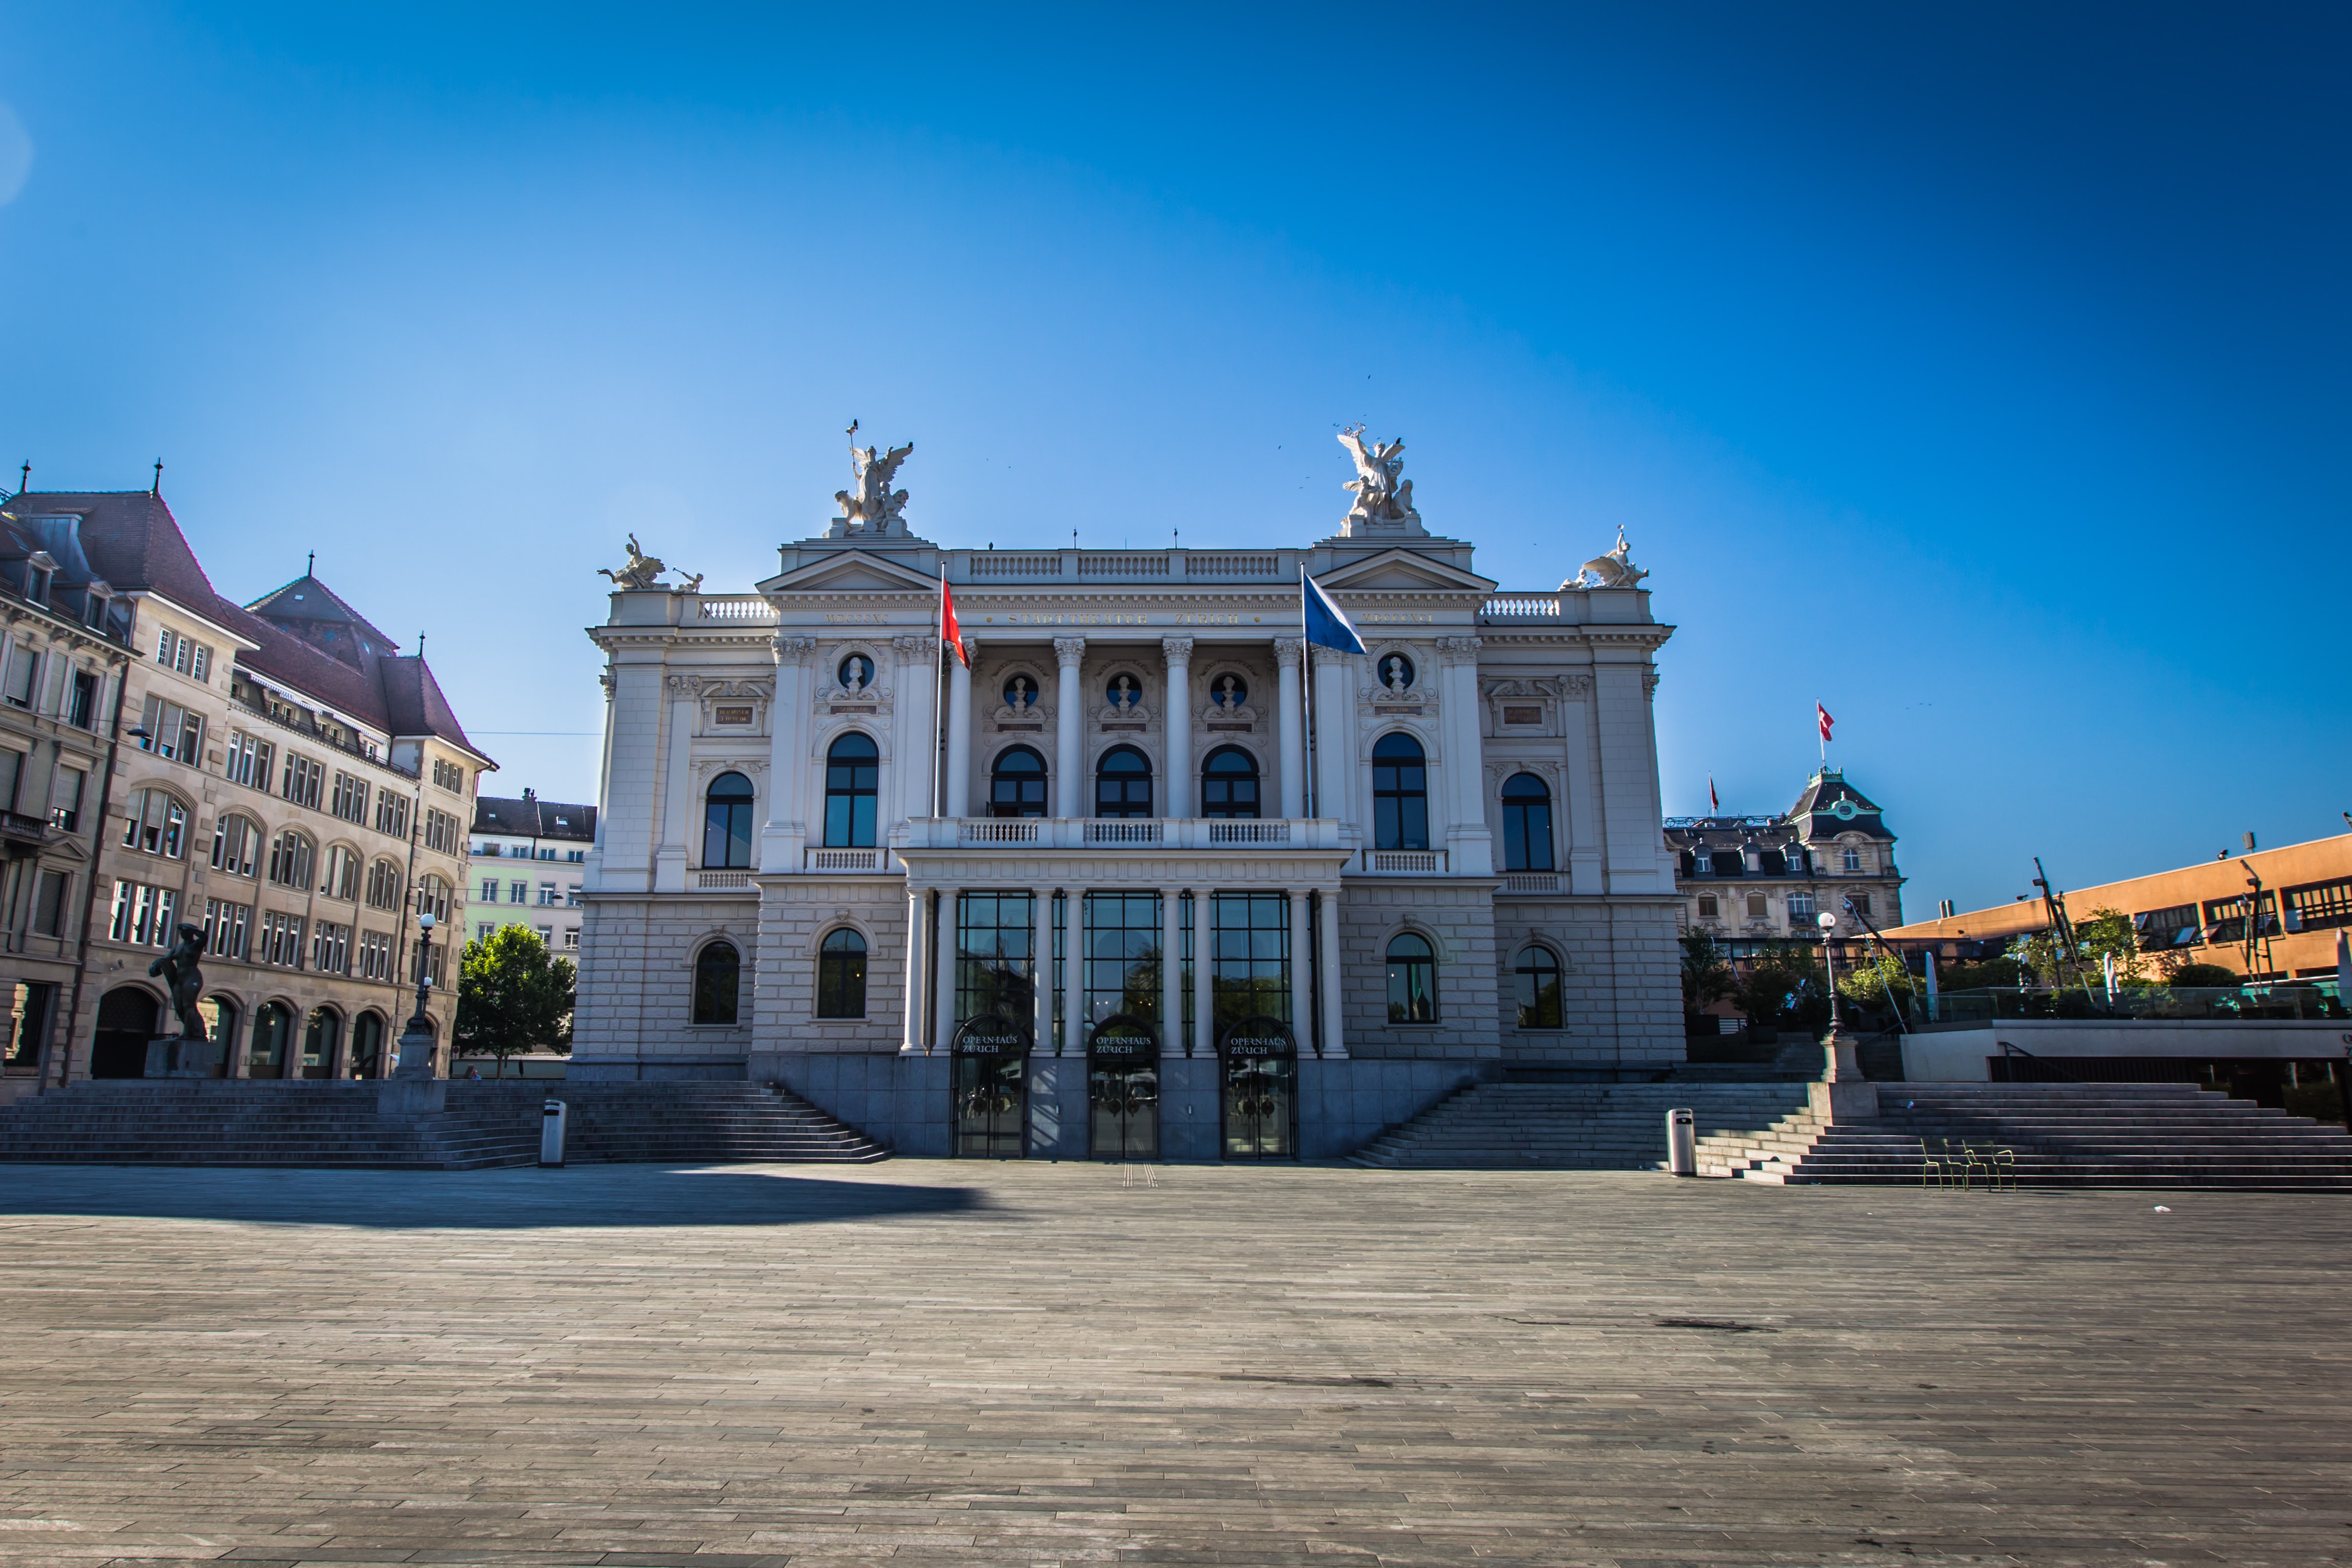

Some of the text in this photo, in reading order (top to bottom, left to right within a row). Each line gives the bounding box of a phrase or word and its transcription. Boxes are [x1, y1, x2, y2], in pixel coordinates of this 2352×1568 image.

[823, 614, 888, 623] MDCCCXC
[1360, 614, 1432, 623] MDCCCXCI
[1096, 1037, 1151, 1045] OPERNHAUS
[963, 1043, 998, 1053] ZÜRICH
[1096, 1044, 1133, 1053] ZÜRICH
[1231, 1045, 1267, 1054] ZÜRICH
